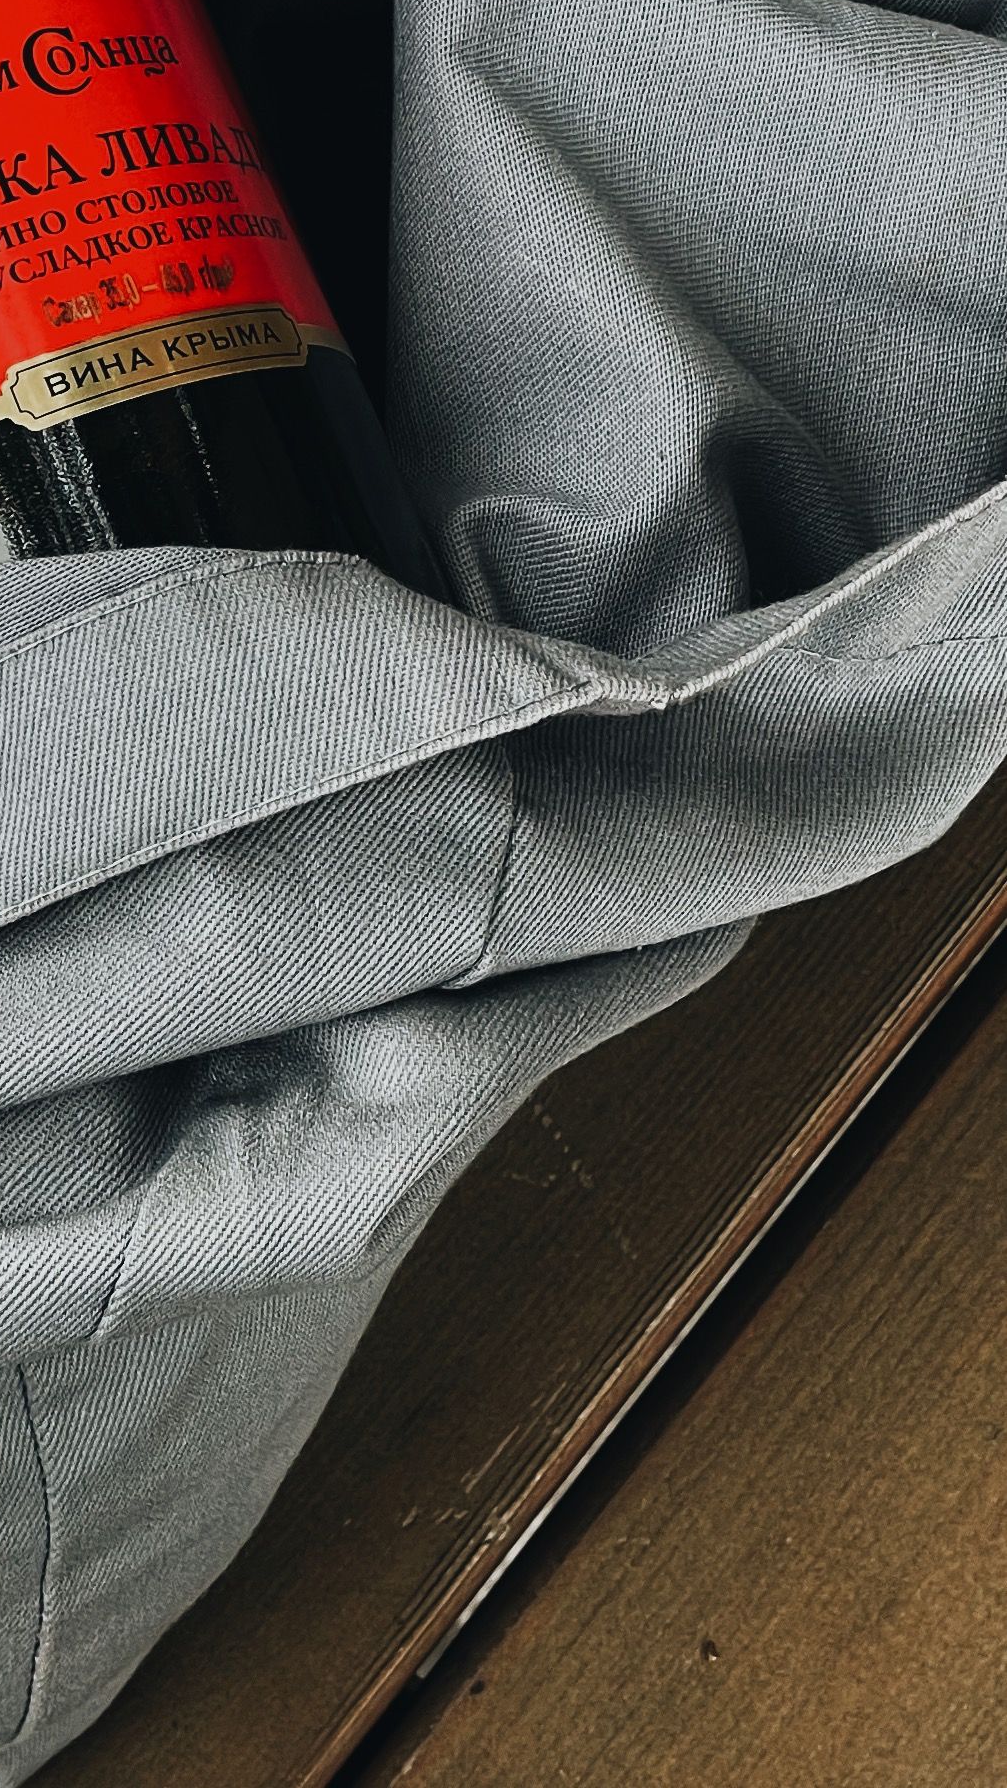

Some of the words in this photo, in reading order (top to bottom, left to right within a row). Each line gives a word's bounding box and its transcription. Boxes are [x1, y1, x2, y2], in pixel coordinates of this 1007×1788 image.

[21, 26, 179, 97] Солнца
[75, 179, 239, 226] СТОЛОВОЕ
[180, 213, 289, 246] КРАСНОЕ
[43, 346, 155, 398] ВИНА
[162, 320, 283, 375] КРЫМА
